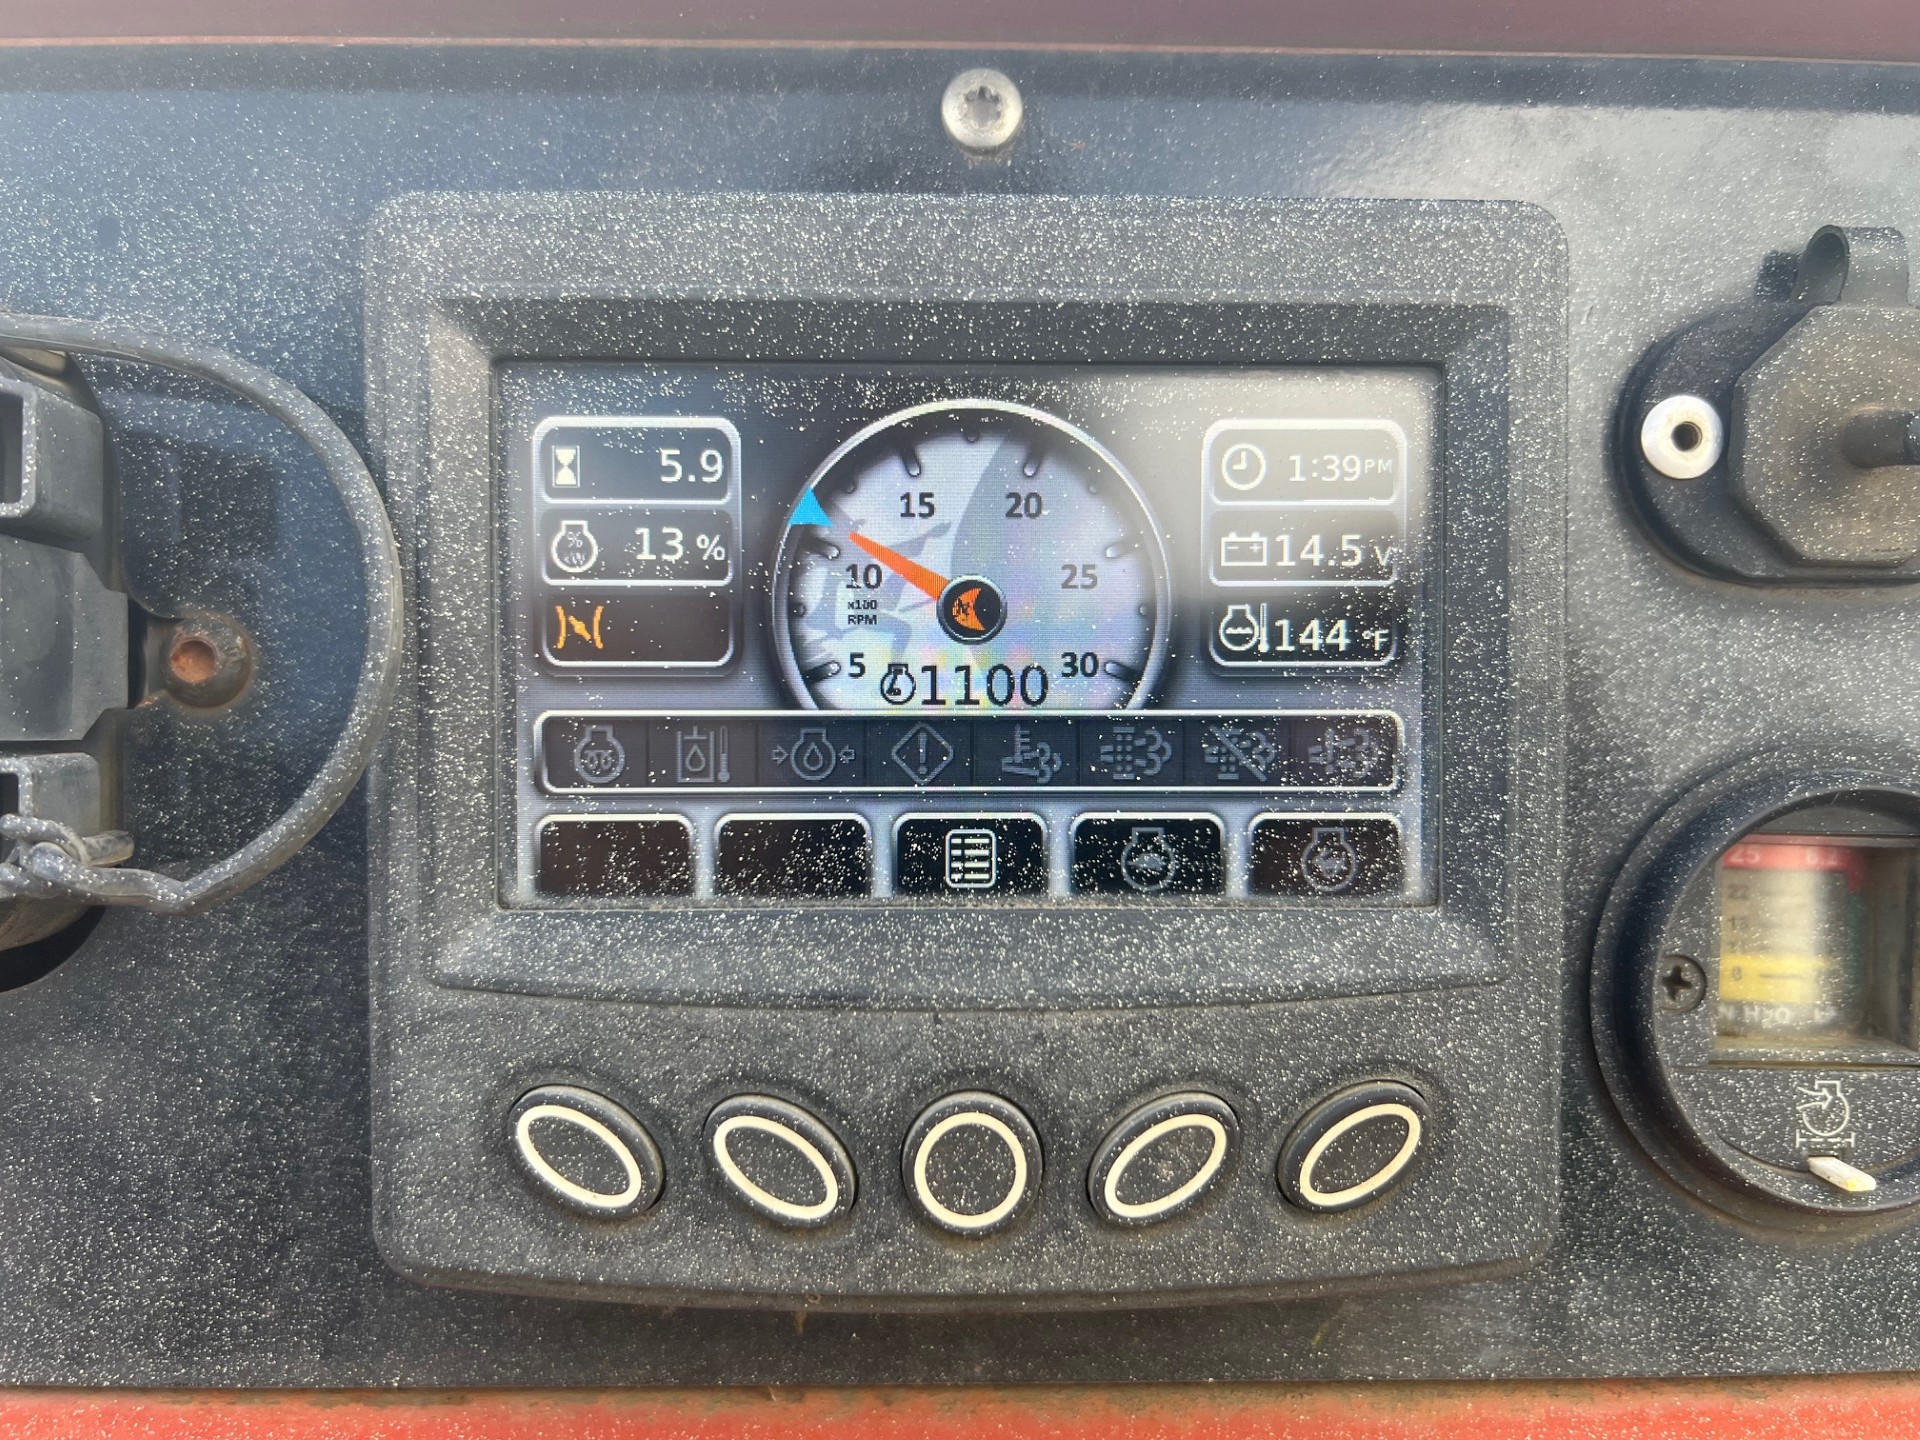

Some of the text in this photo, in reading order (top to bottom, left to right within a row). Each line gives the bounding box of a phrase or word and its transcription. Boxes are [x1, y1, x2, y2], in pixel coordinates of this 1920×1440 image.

[661, 449, 724, 482] 5.9
[899, 492, 936, 518] 15
[1005, 491, 1043, 519] 20
[634, 526, 726, 561] 13 %
[1275, 534, 1363, 567] 14.5
[845, 563, 883, 589] 10
[1060, 563, 1099, 590] 25
[847, 599, 878, 610] x100
[847, 614, 878, 625] RPM
[1275, 618, 1350, 651] 144
[848, 652, 866, 678] 5
[1060, 651, 1100, 678] 30
[920, 663, 1049, 706] 1100
